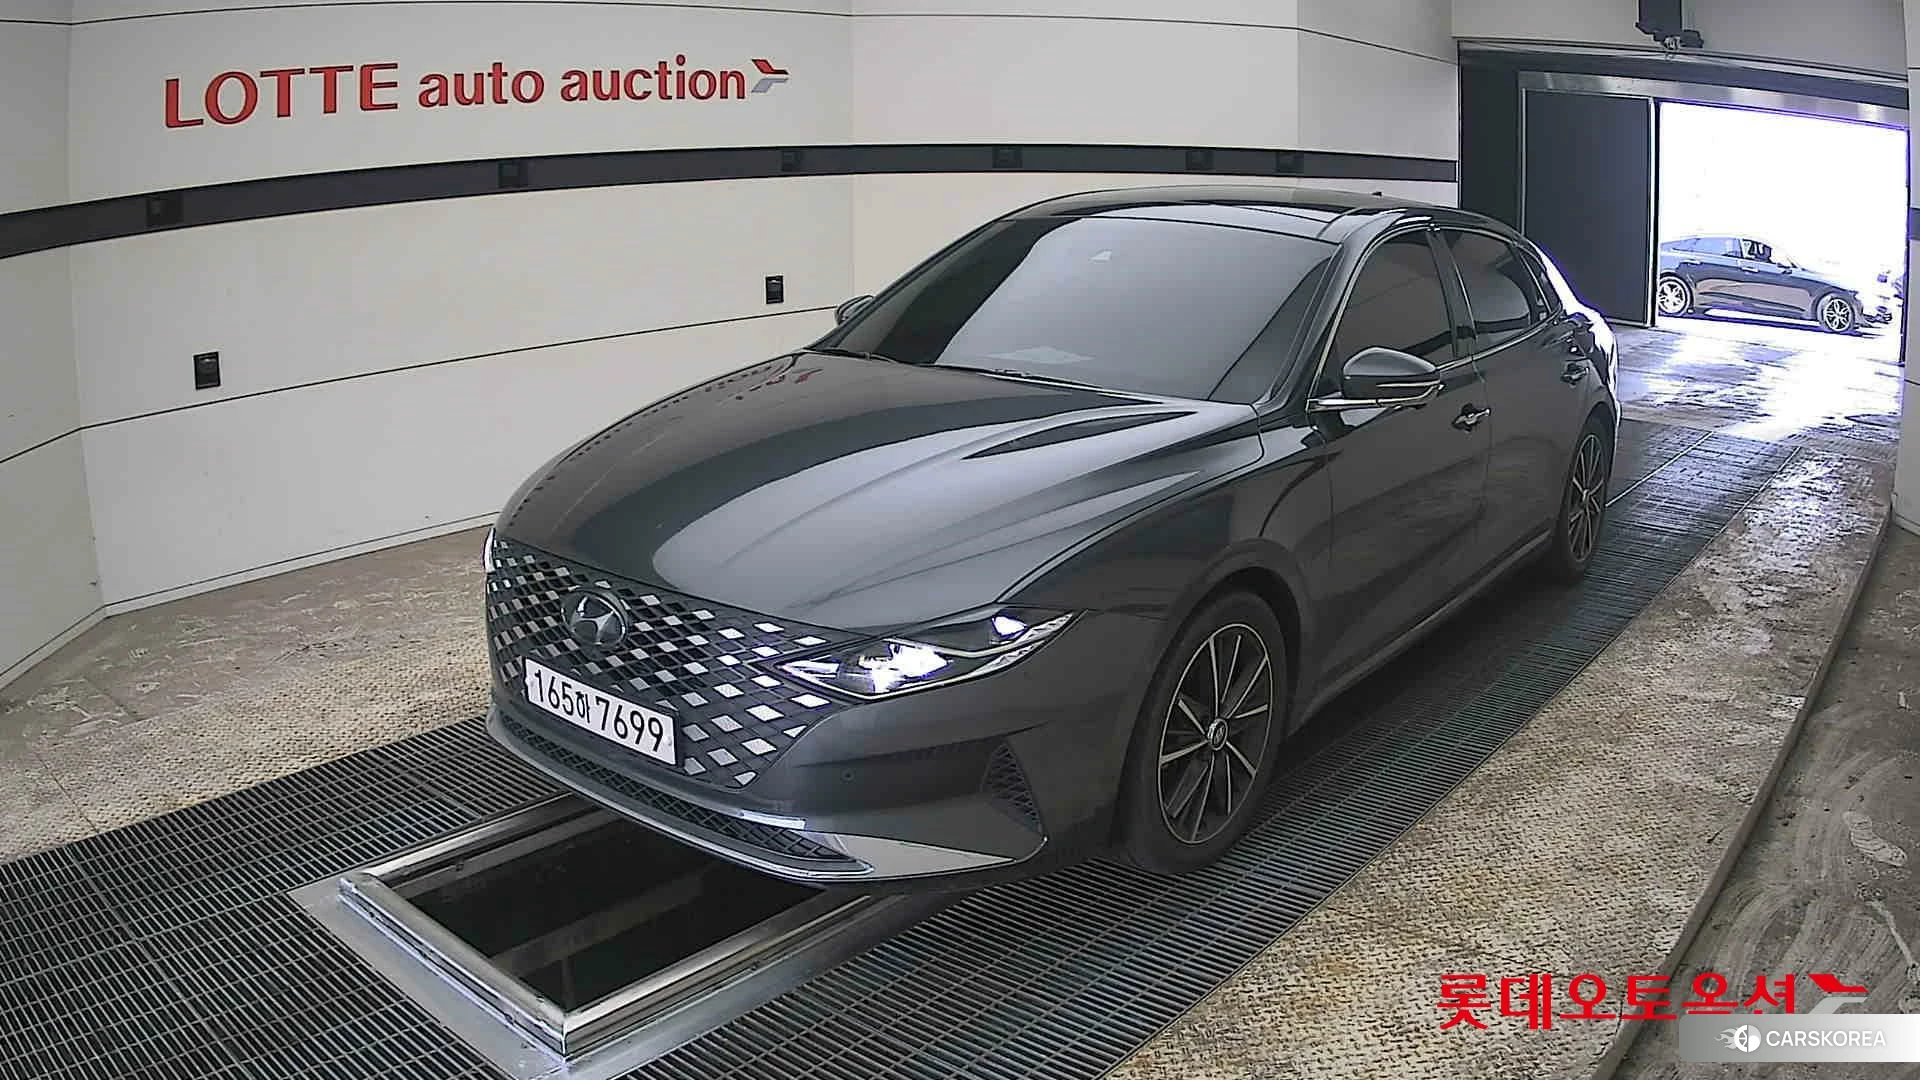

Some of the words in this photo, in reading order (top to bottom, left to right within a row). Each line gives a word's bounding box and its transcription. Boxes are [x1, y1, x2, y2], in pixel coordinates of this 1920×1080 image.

[164, 62, 400, 129] LOTTE
[418, 61, 546, 108] auto
[560, 54, 748, 102] auction
